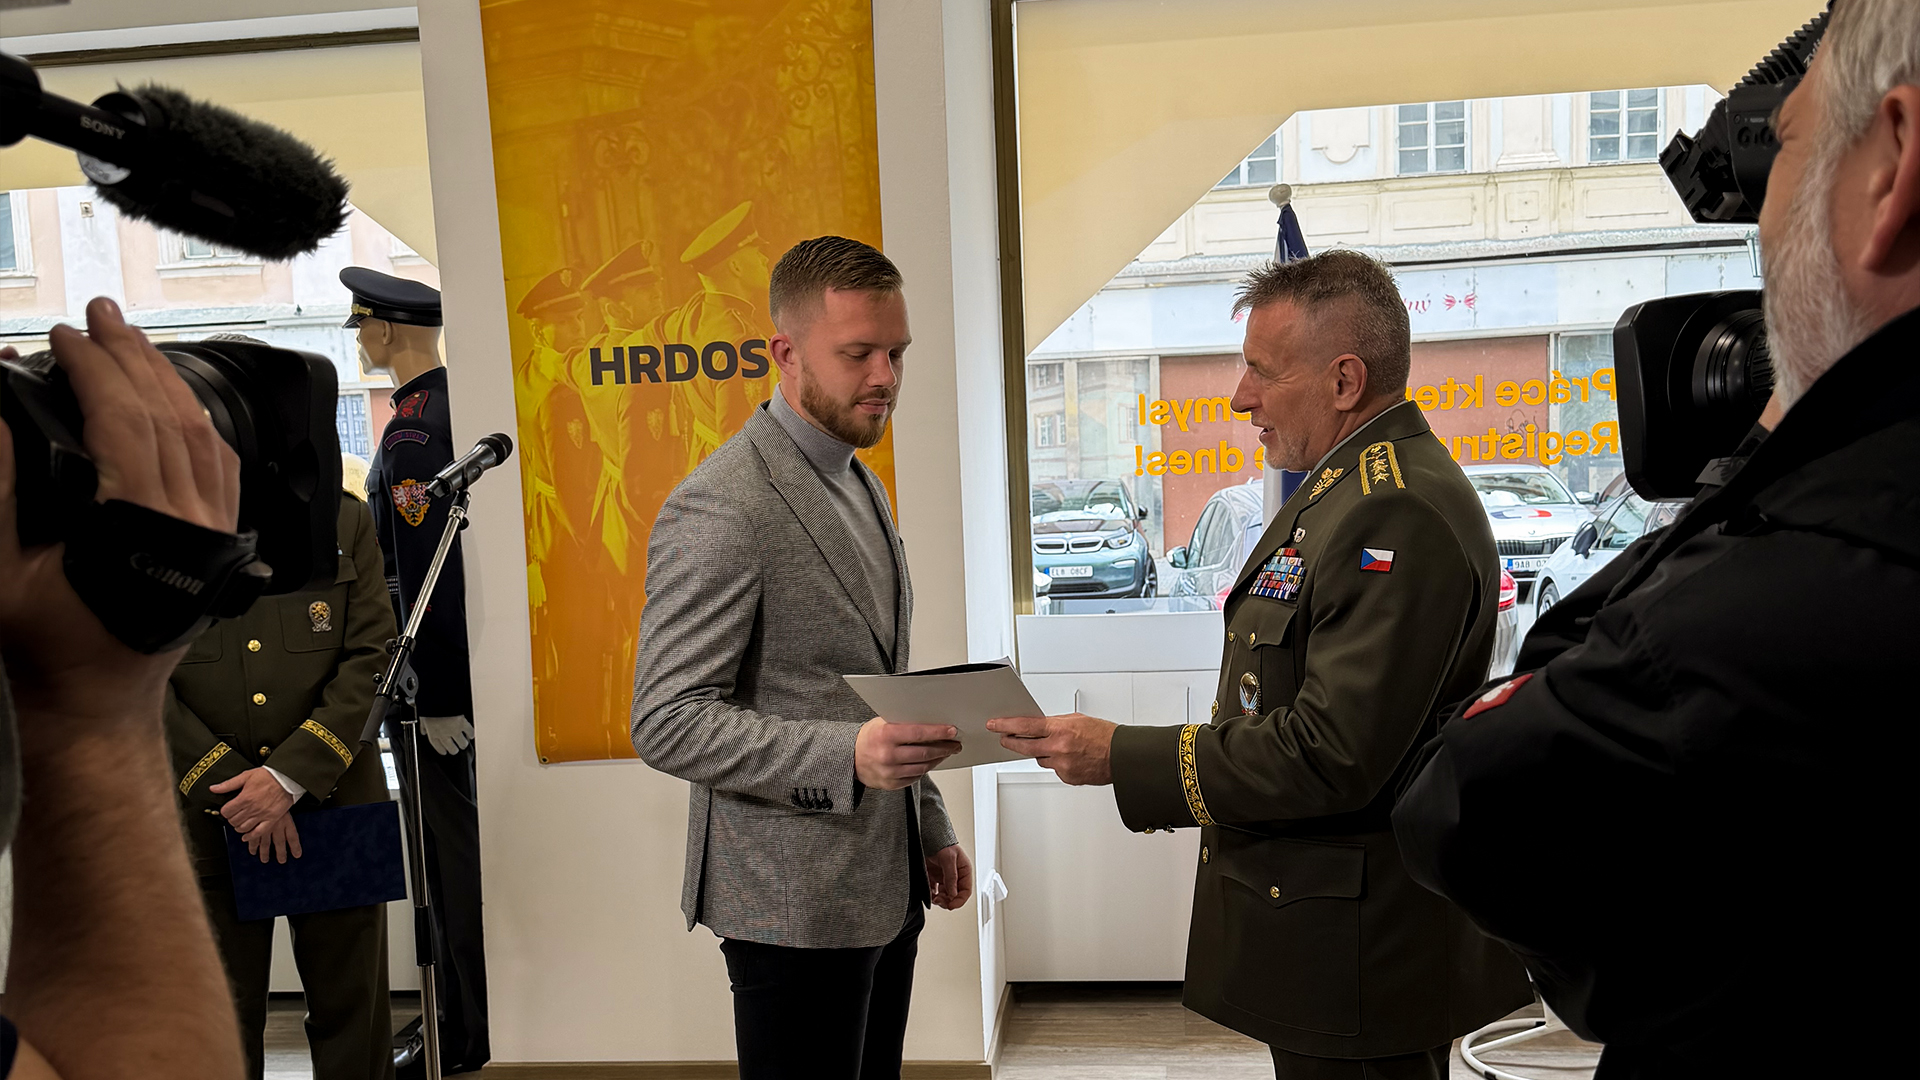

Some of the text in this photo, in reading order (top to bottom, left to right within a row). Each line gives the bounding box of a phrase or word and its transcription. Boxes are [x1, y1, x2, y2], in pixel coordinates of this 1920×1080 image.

[80, 115, 126, 139] SONY
[589, 338, 771, 386] HRDOS
[129, 551, 206, 596] Canon
